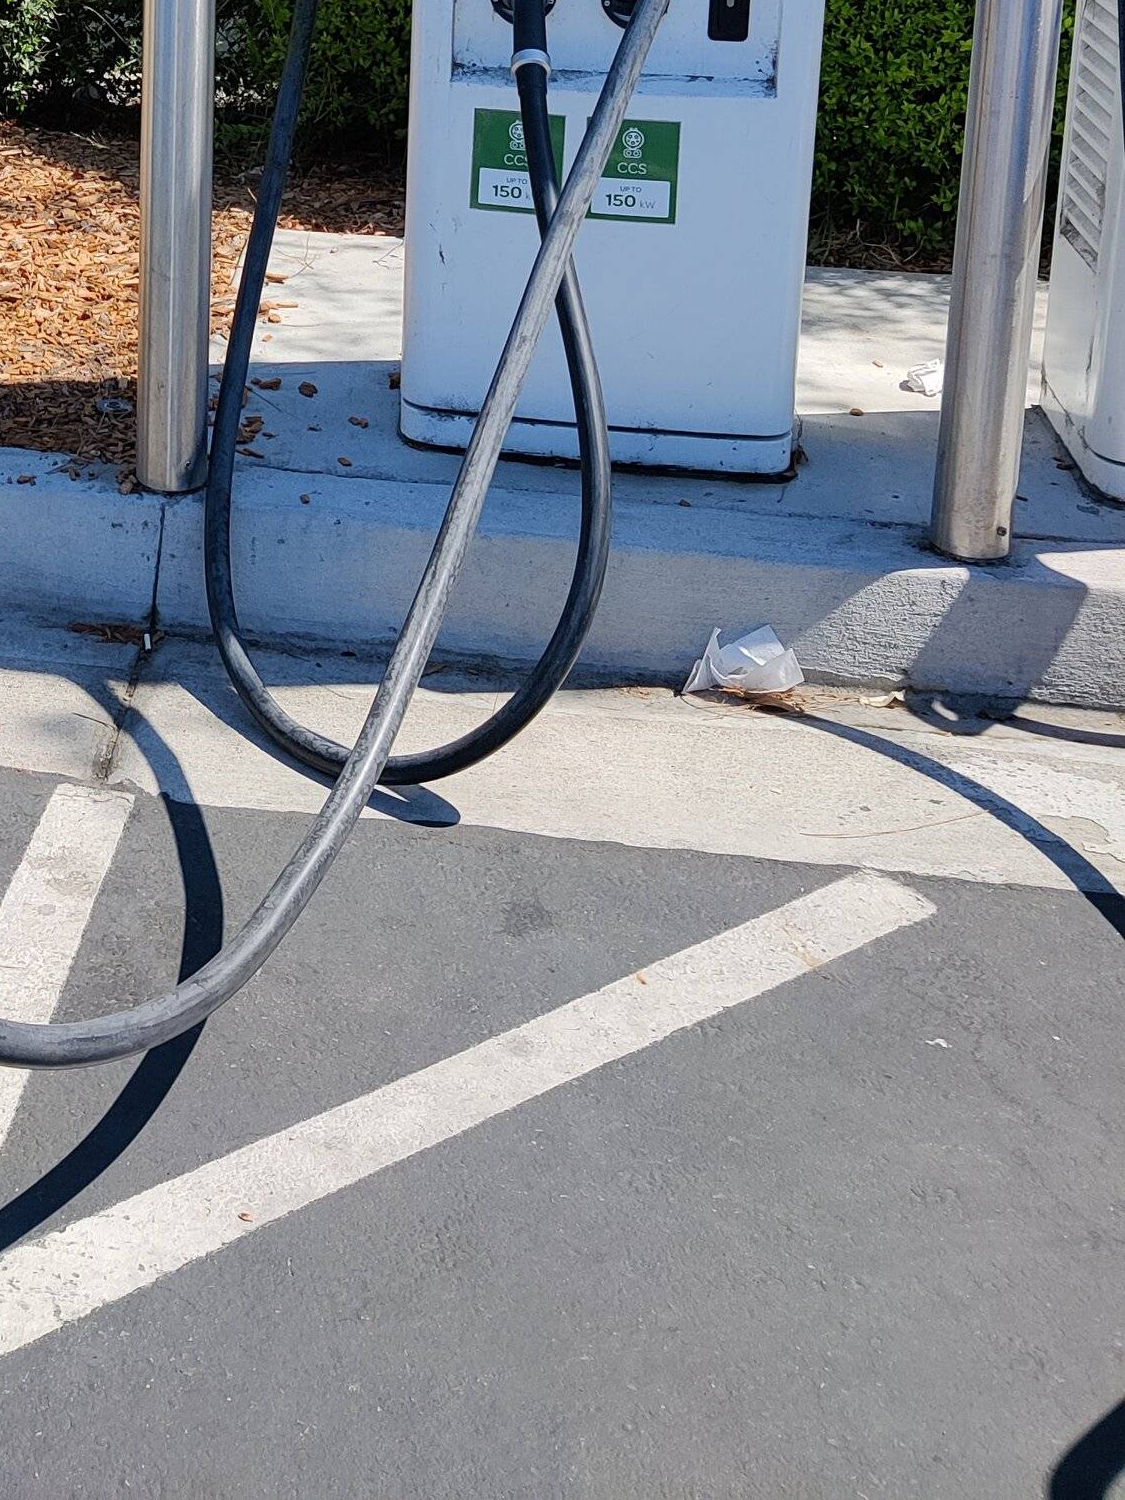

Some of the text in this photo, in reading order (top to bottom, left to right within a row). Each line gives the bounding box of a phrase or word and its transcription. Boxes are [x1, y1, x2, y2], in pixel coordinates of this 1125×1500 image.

[617, 162, 647, 175] CCS
[492, 184, 522, 199] 150
[605, 193, 656, 209] 150 kW
